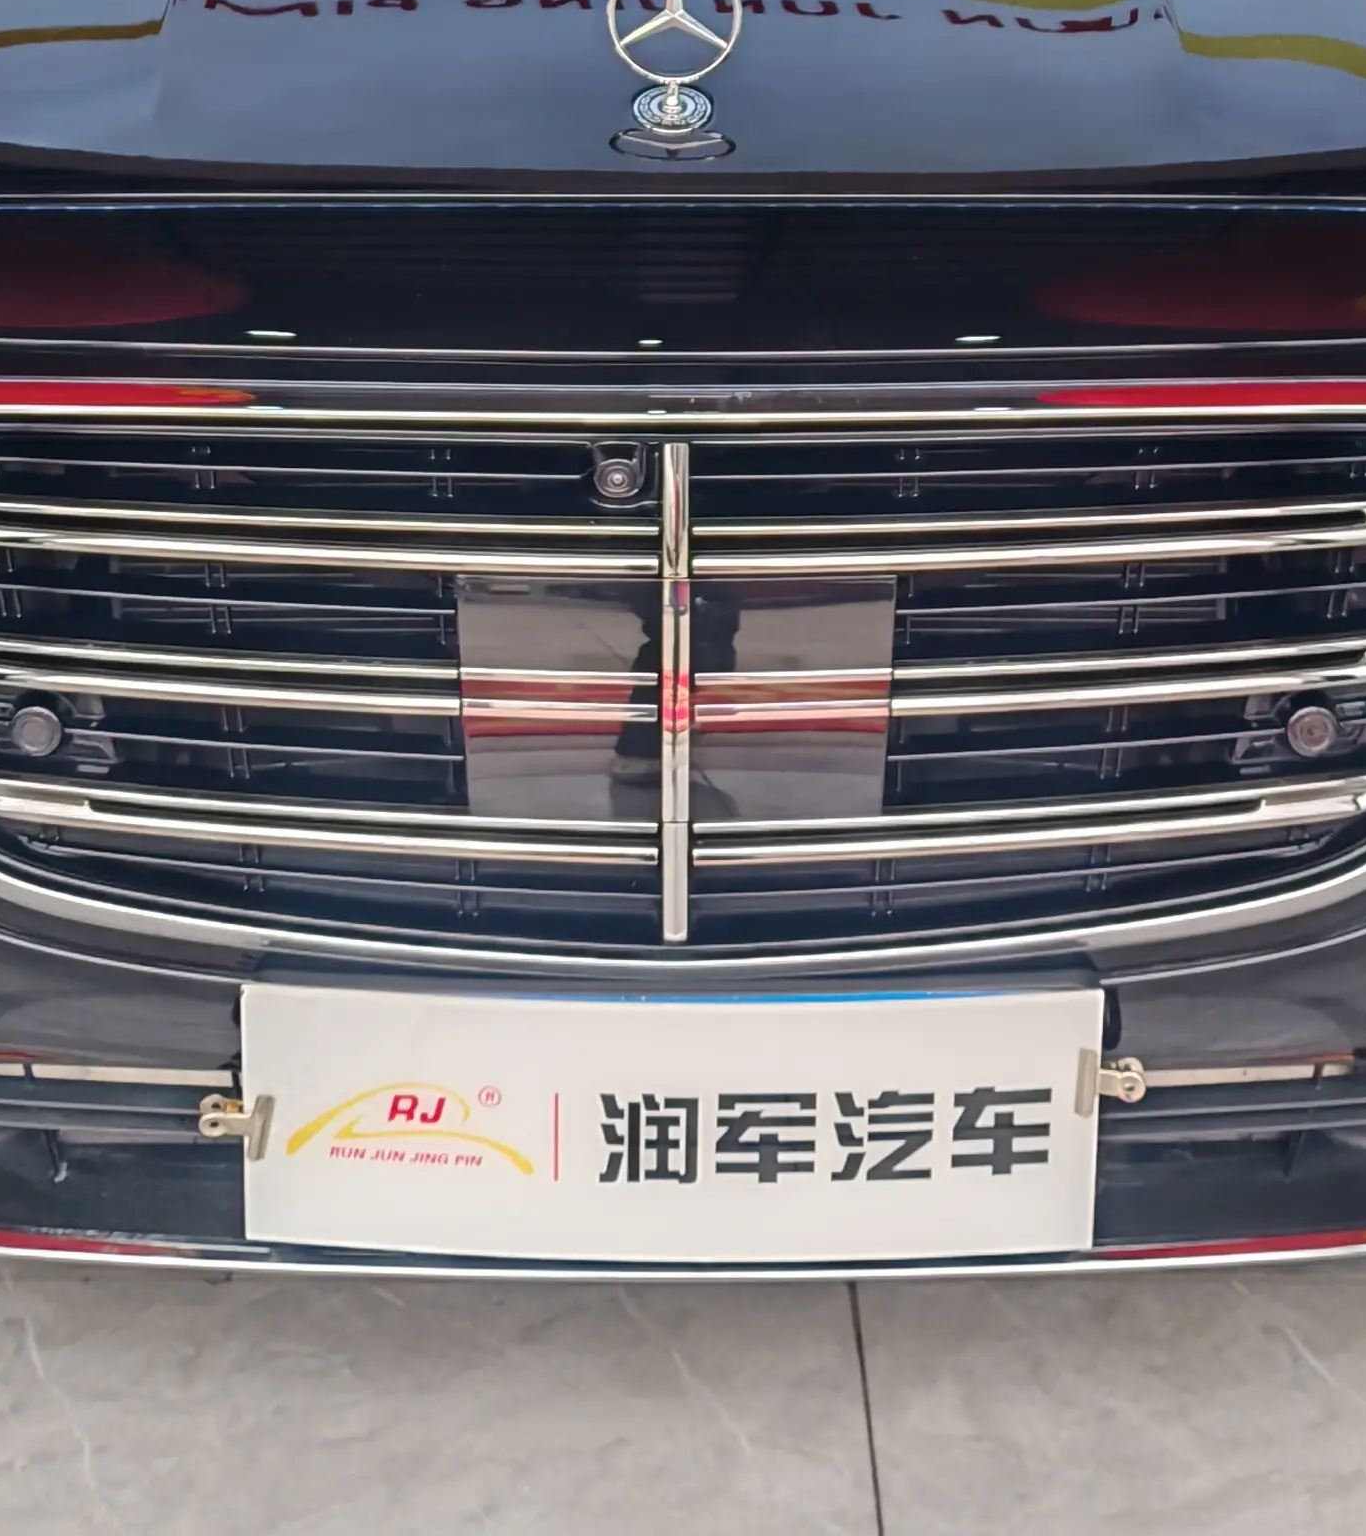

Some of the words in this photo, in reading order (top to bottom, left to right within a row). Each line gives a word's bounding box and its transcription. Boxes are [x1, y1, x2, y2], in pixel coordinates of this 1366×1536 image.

[387, 1093, 448, 1125] RJ
[597, 1085, 1054, 1186] 润军汽车
[328, 1145, 367, 1160] RUN
[369, 1148, 406, 1163] JUN
[409, 1151, 450, 1166] JING
[453, 1154, 484, 1168] PIN
